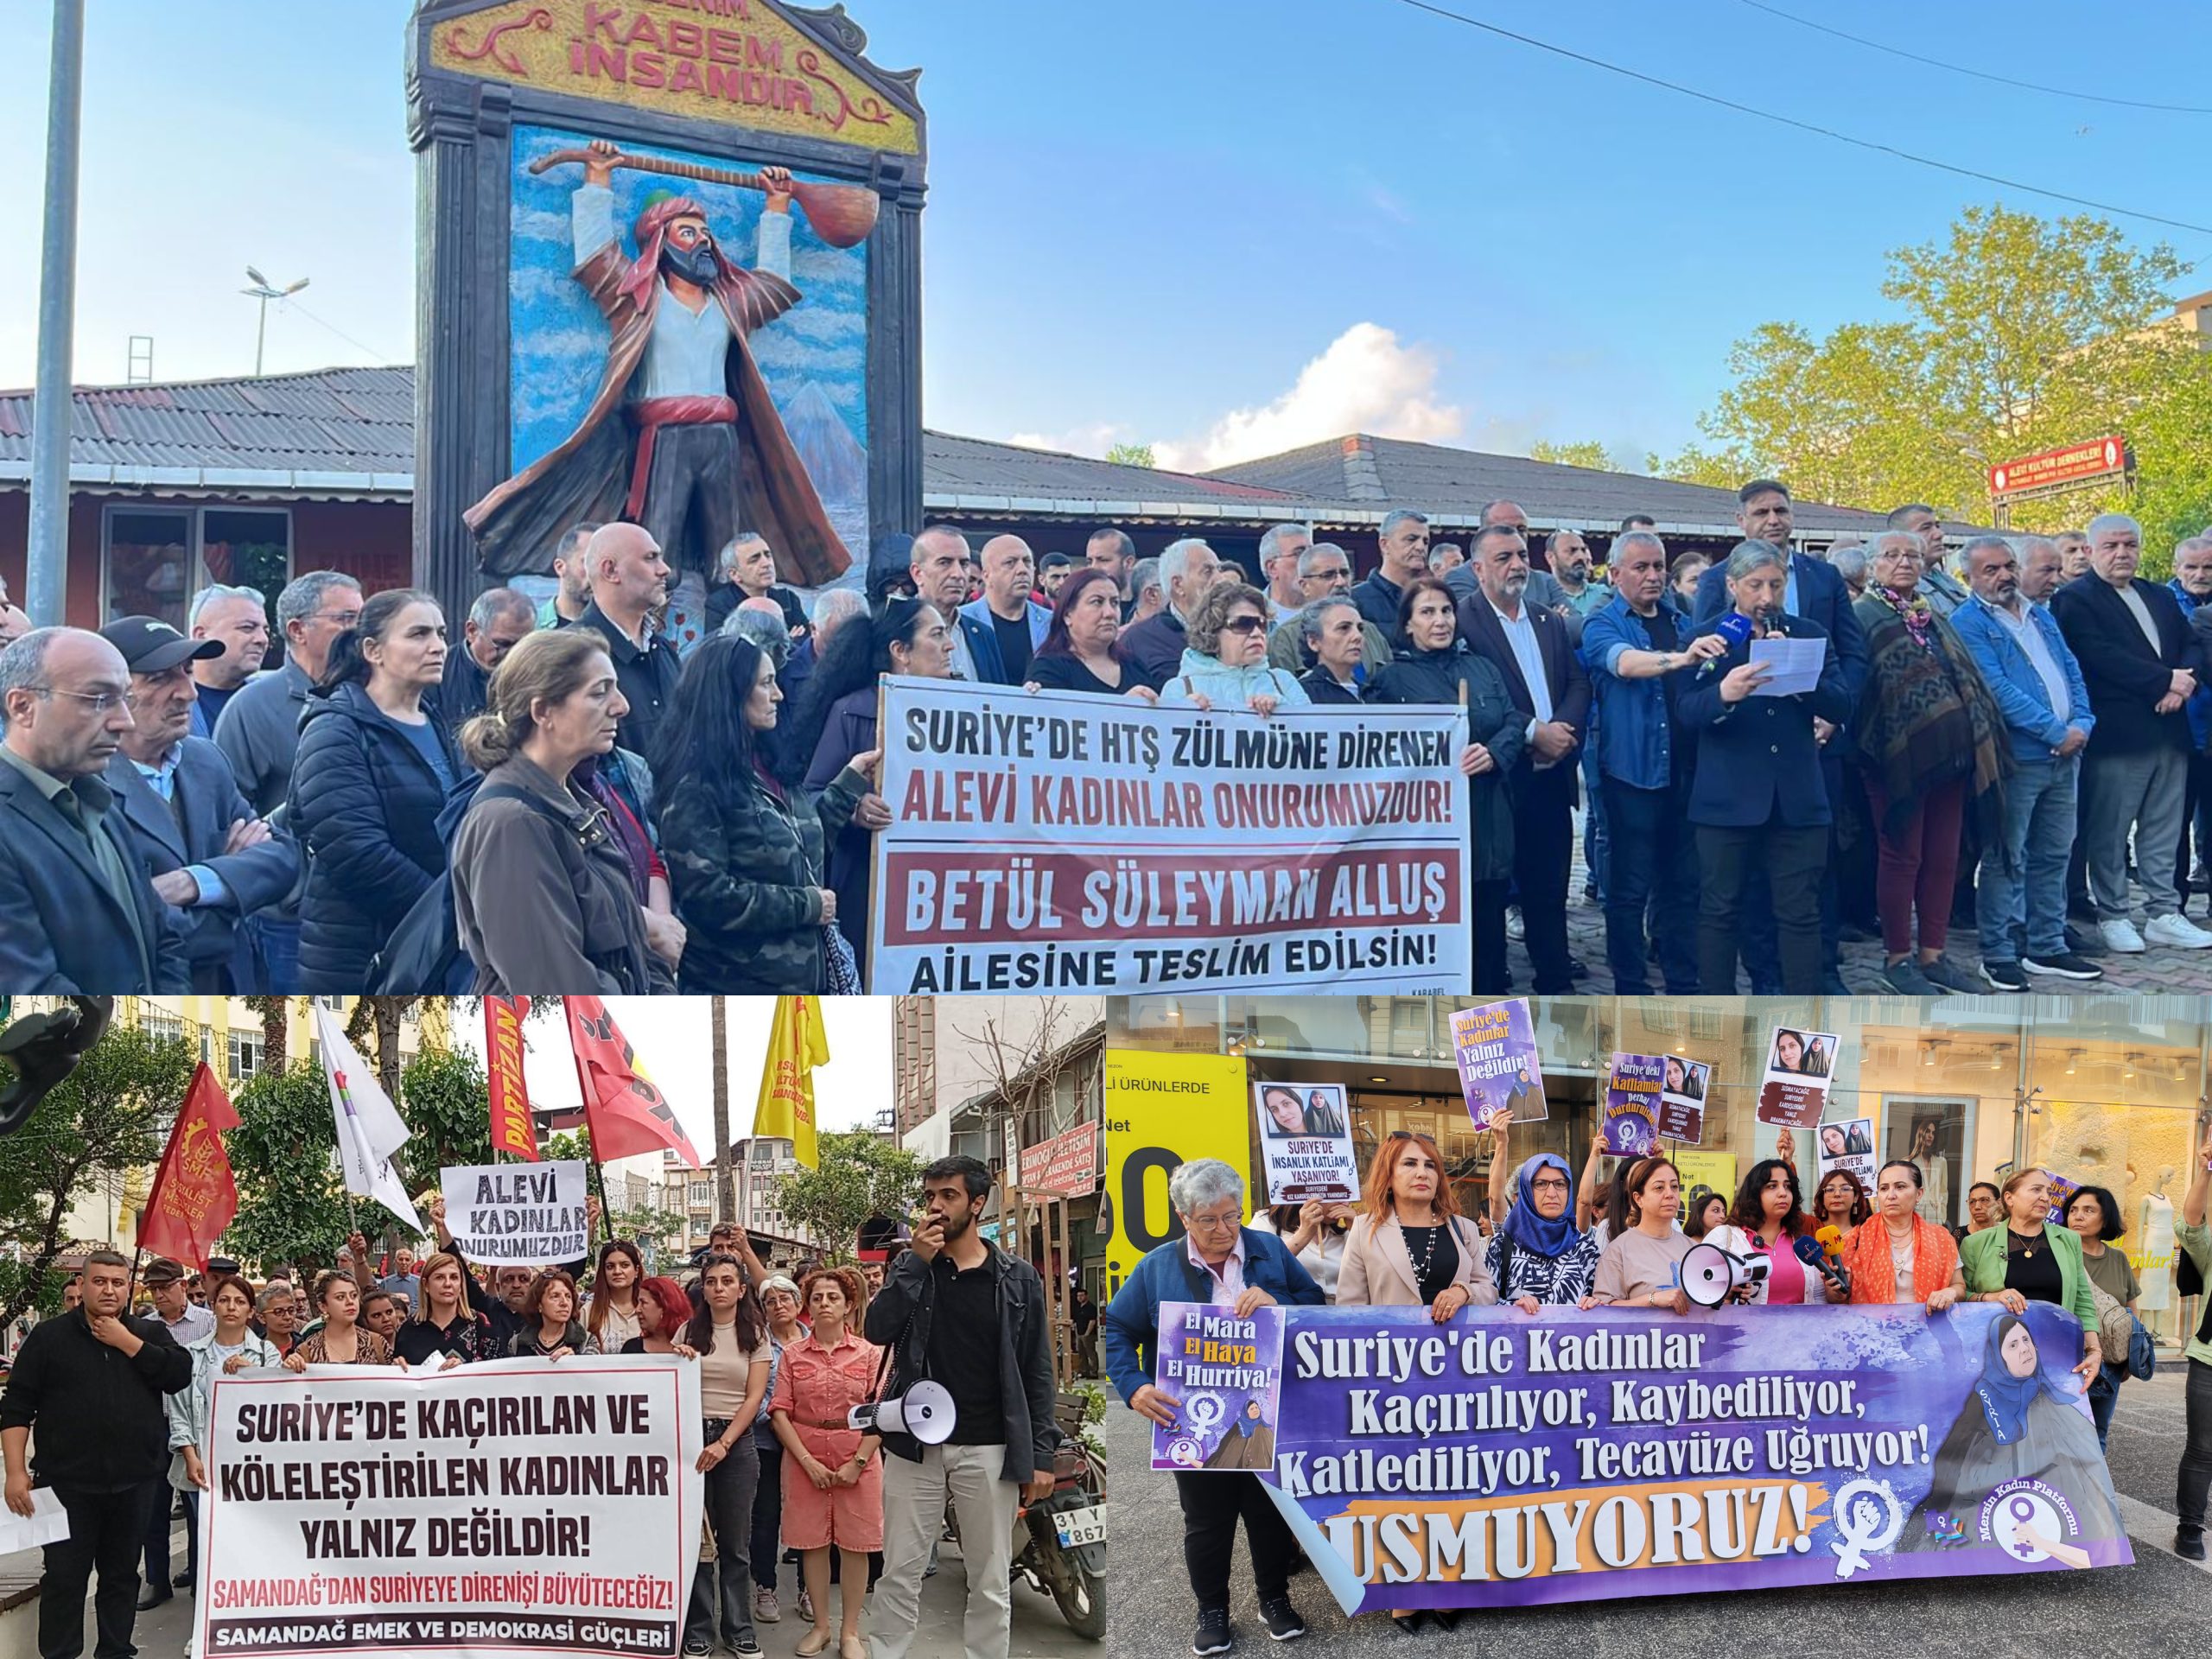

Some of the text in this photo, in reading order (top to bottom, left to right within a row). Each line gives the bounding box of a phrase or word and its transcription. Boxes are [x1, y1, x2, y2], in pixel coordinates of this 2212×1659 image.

[583, 2, 782, 73] KABEM
[906, 703, 1452, 772] SURİYE'DE HTŞ ZÜLMÜNE DİRENEN
[901, 764, 1452, 829] ALEVİ KADINLAR ONURUMUZDUR!
[905, 857, 1446, 932] BETÜL SÜLEYMAN ALLUŞ
[909, 928, 1438, 994] AİLESİNE TESLİM EDİLSİN!
[1456, 1009, 1510, 1033] Suriye'de
[1458, 1025, 1510, 1047] Kadınlar
[1462, 1042, 1505, 1065] Yalnız
[1465, 1054, 1528, 1083] Değildir!
[1120, 1077, 1210, 1094] ÜRÜNLERDE
[1611, 1076, 1662, 1093] Katliamlar
[1271, 1154, 1312, 1169] İNSANLIK
[1291, 1169, 1340, 1185] YAŞANIYOR!
[475, 1167, 557, 1205] ALEVİ
[469, 1206, 588, 1235] KADINLAR
[1185, 1312, 1256, 1339] El Mara
[1185, 1337, 1256, 1365] El Haya
[1295, 1328, 1706, 1382] Suriye'de Kadınlar
[1166, 1359, 1273, 1390] El Hurriya!
[236, 1394, 650, 1449] SURİYE'DE KAÇIRILAN VE
[1349, 1376, 1866, 1440] Kaçırılıyor, Kaybediliyor,
[1980, 1389, 2005, 1440] SYRIA
[220, 1452, 670, 1510] KÖLELEŞTİRİLEN KADINLAR
[1278, 1423, 1931, 1502] Katlediliyor, Tecavüze Uğruyor!
[1056, 1512, 1077, 1528] 31
[1980, 1478, 2081, 1541] Mersin Kadın Platformu
[299, 1507, 591, 1559] YALNIZ DEĞİLDİR!
[1072, 1524, 1104, 1543] 867
[1320, 1481, 1813, 1586] USMUYORUZ!
[213, 1569, 673, 1611] SAMANDAĞ'DAN SURİYEYE DİRENİŞİ BÜYÜTECEĞİZ!
[215, 1618, 671, 1650] SAMANDAĞ EMEK VE DEMOKRASİ GÜÇLERİ
